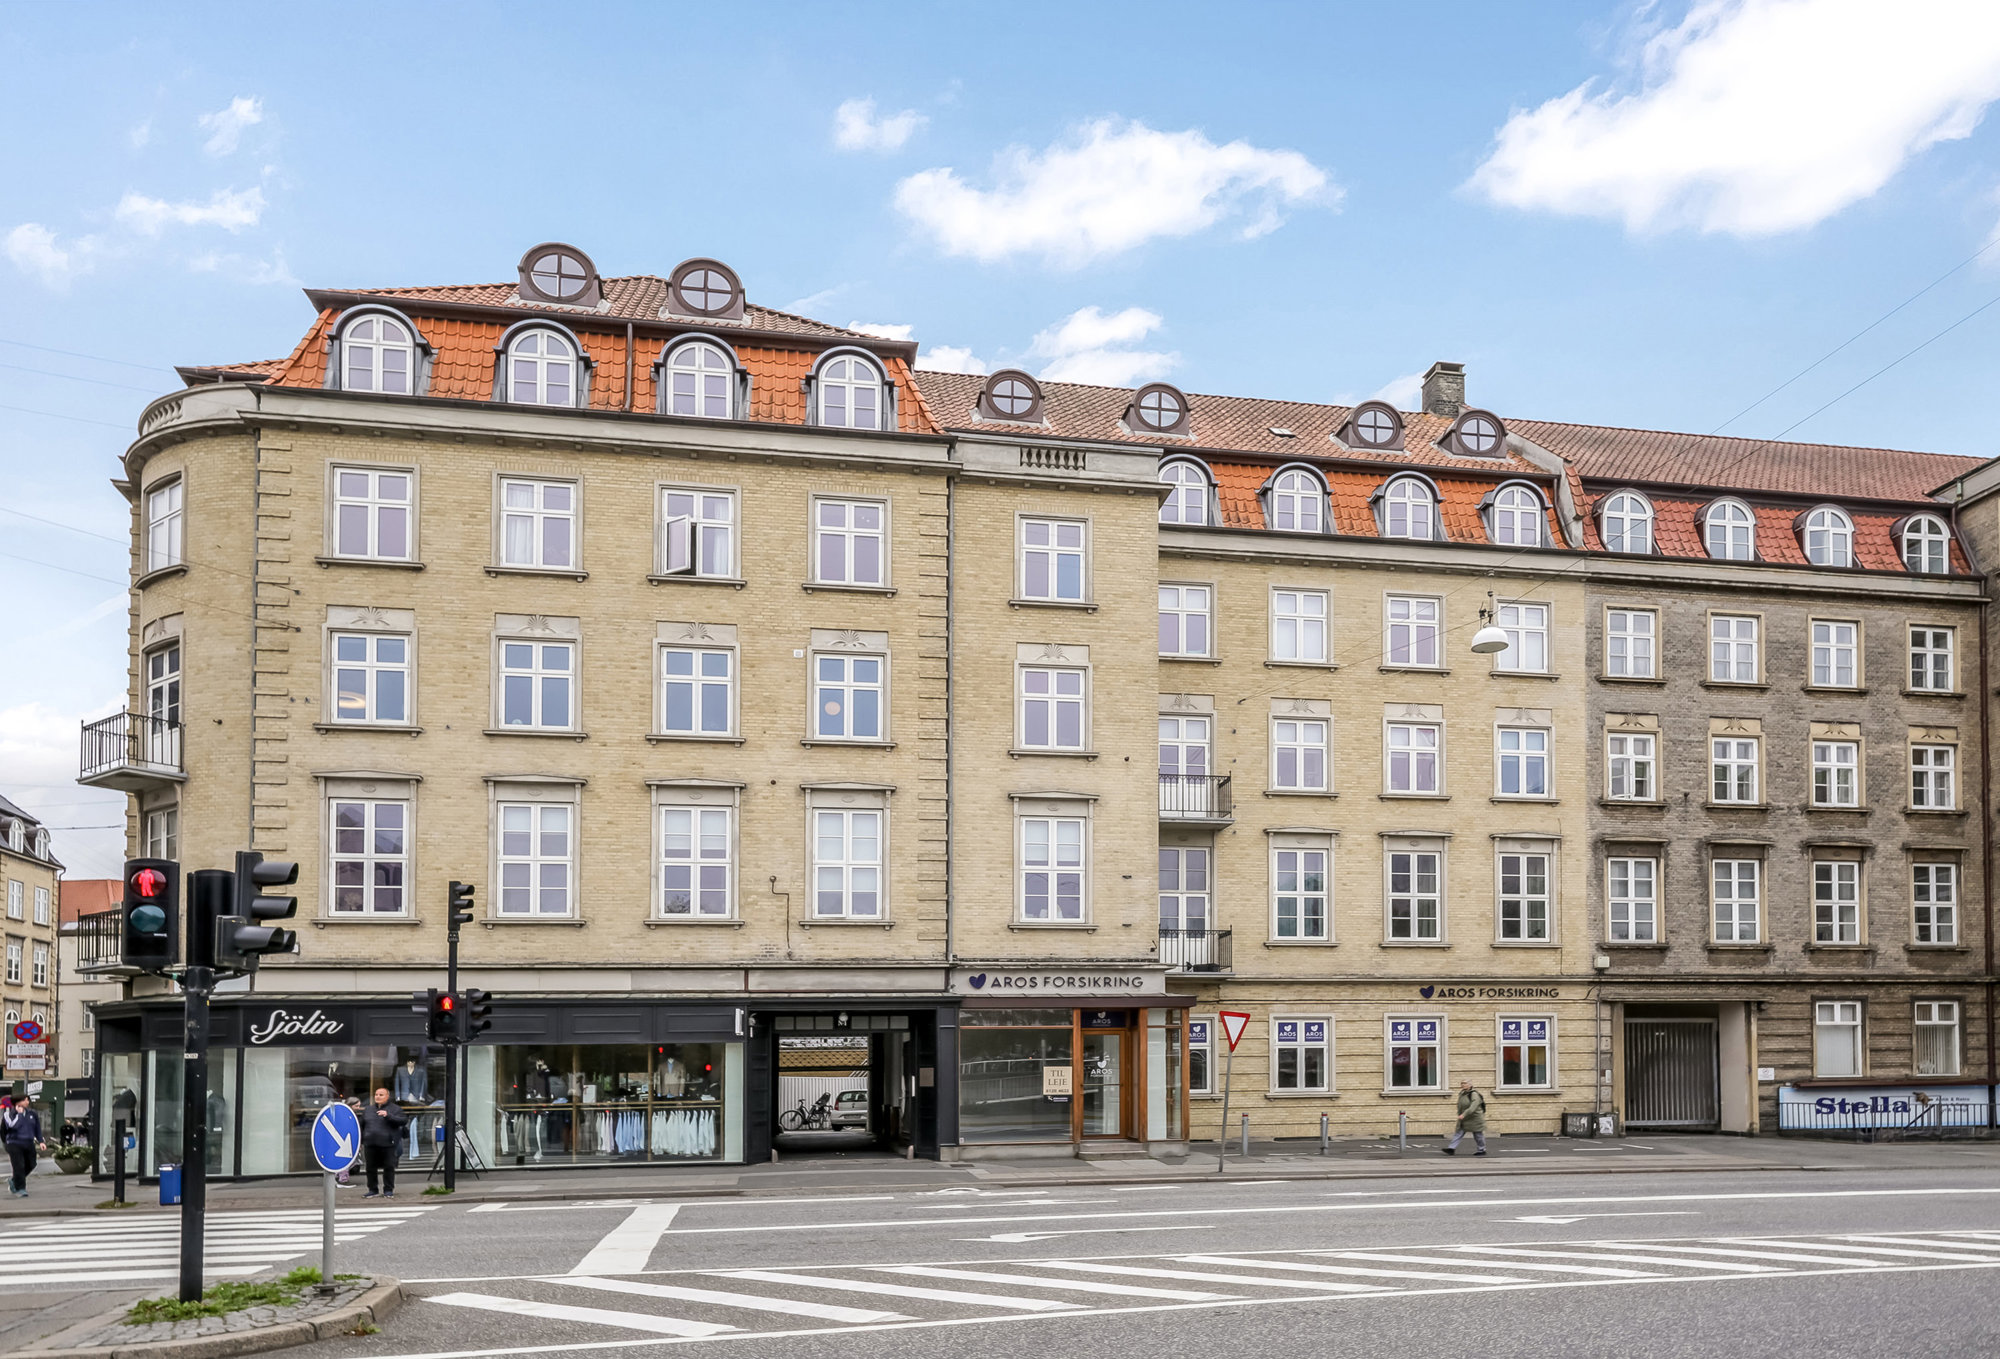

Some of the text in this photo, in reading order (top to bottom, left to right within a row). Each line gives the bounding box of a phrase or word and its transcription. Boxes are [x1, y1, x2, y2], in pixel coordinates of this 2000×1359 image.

[990, 976, 1144, 988] AROS FORSIKRING
[1437, 988, 1559, 998] AROS FORSIKRING
[250, 1009, 344, 1044] Sjölin
[1048, 1078, 1068, 1086] LEJE
[1815, 1096, 1911, 1114] Stella
